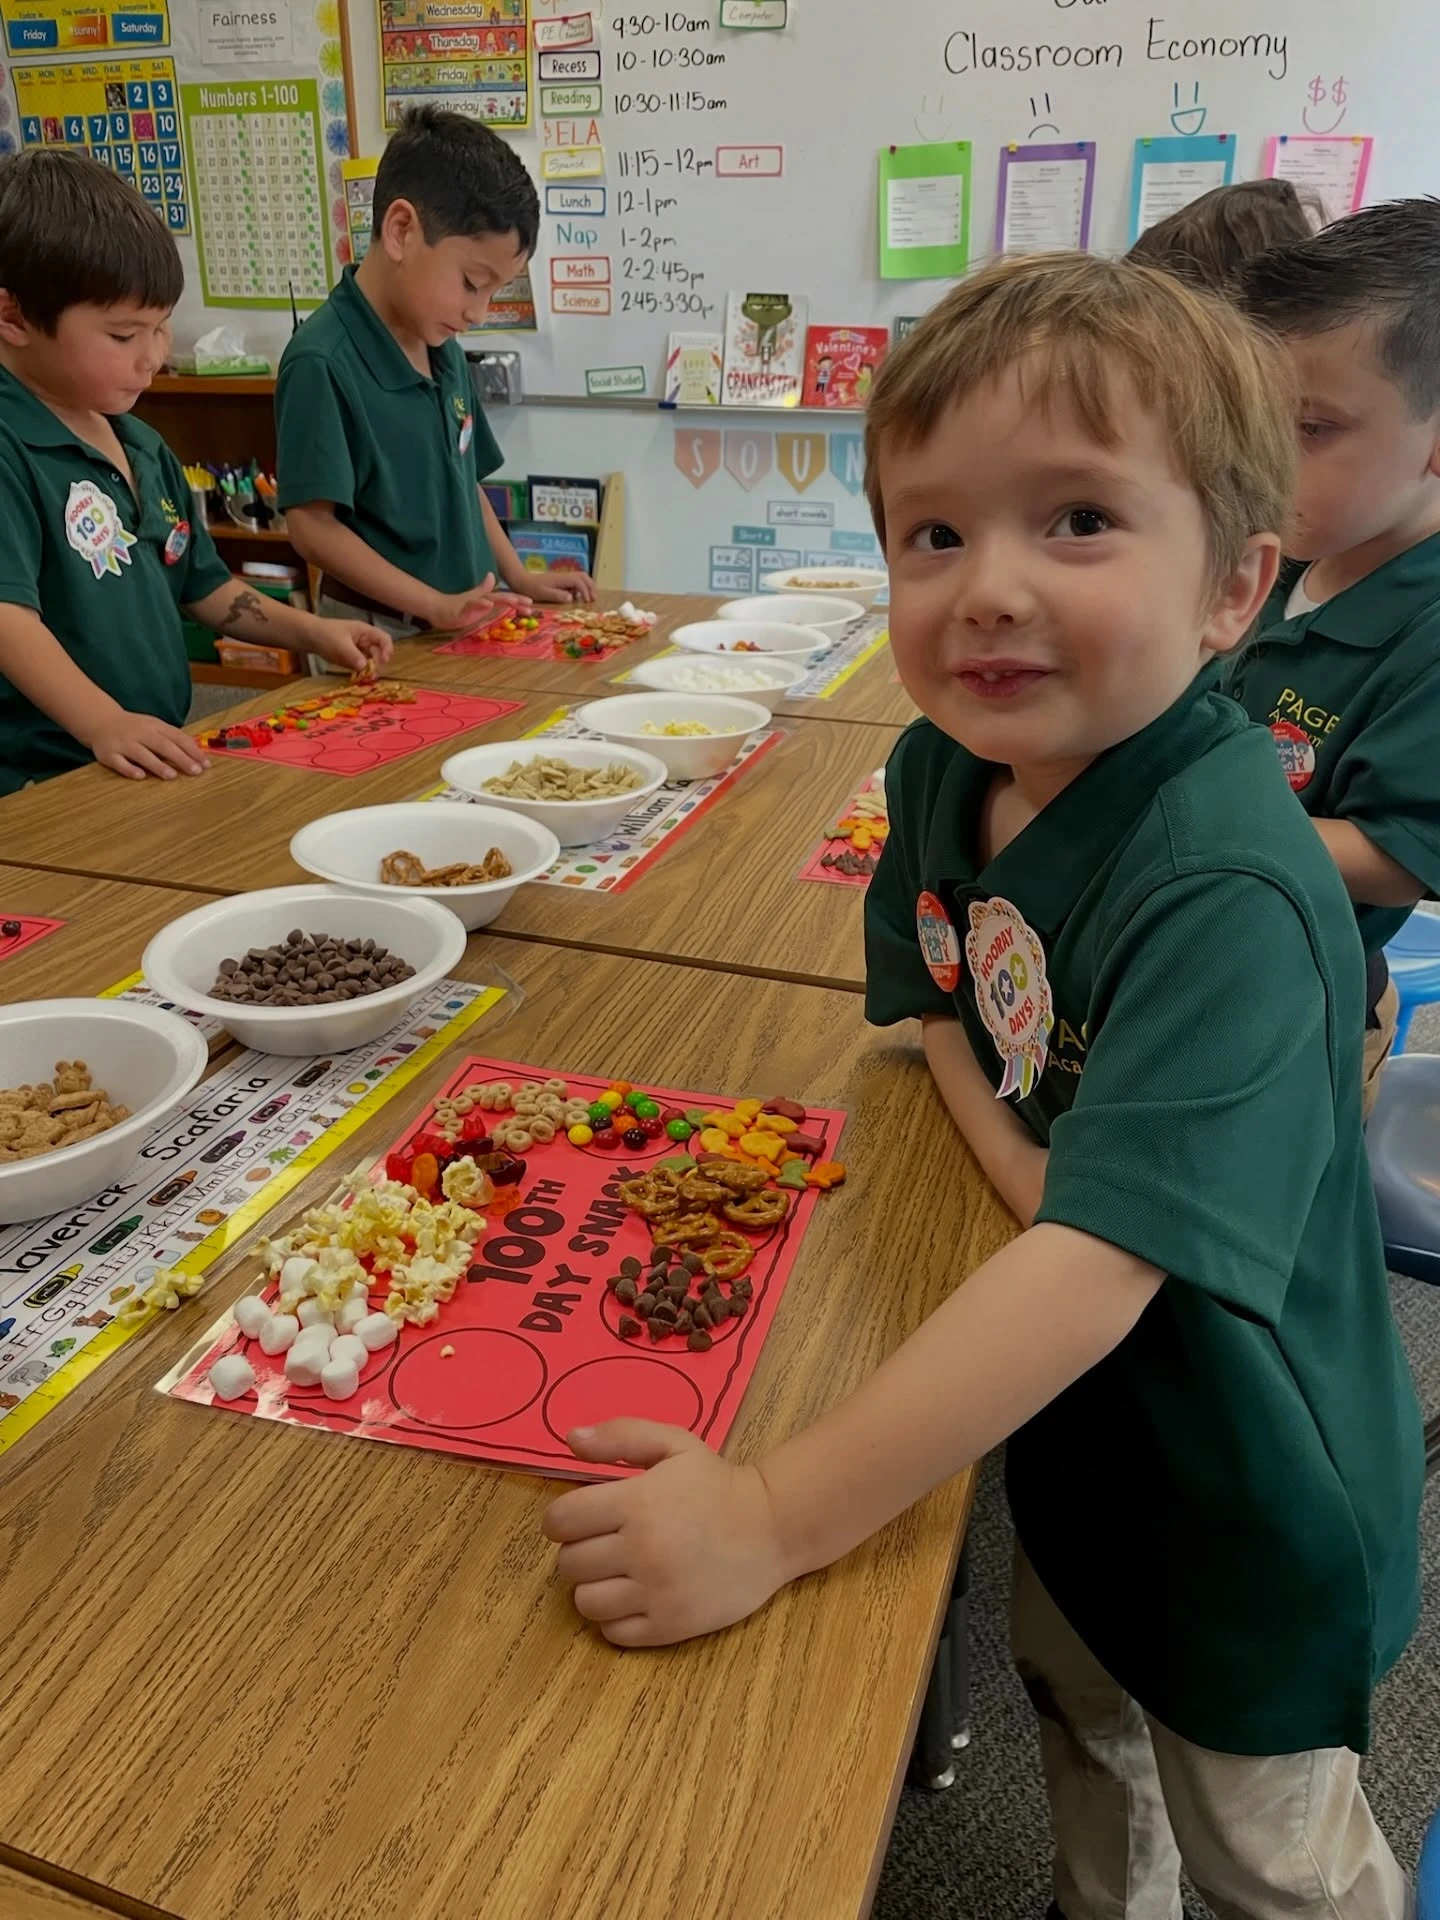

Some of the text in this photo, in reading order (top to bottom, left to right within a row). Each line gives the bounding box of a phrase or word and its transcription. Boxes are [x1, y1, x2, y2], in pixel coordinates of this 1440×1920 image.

[212, 12, 277, 26] Fairness
[426, 5, 483, 17] Wednesday
[23, 30, 47, 42] Friday
[74, 26, 97, 36] sunny
[121, 22, 157, 35] Saturday
[430, 34, 479, 49] Thursday
[943, 17, 1289, 79] Classroom Economy
[552, 59, 587, 73] Recess
[437, 71, 468, 82] Friday
[133, 84, 167, 103] 2 3
[200, 84, 298, 108] Numbers 1-100
[551, 89, 592, 109] Reading
[28, 115, 175, 136] 4 6 7 8 10
[556, 119, 600, 145] ELA
[95, 145, 177, 165] 14 15 16 17
[738, 154, 760, 168] Art
[142, 176, 182, 193] 23 24
[559, 193, 591, 208] Lunch
[170, 206, 185, 222] 31
[557, 222, 598, 249] Nap
[566, 263, 595, 278] Math
[562, 293, 600, 307] Science
[815, 341, 877, 357] Valentine's
[589, 373, 642, 388] Social Studies
[70, 495, 93, 523] HOORAY
[537, 503, 593, 518] COLOR
[77, 507, 104, 540] 100
[1276, 688, 1340, 734] PAGE
[613, 796, 675, 836] William
[980, 926, 1015, 981] HOORAY
[990, 952, 1028, 1020] 100
[1008, 995, 1036, 1036] DAYS!
[0, 1077, 273, 1274] averick Scafaria
[466, 1178, 567, 1285] 100TH
[518, 1166, 647, 1333] DAY SNACK
